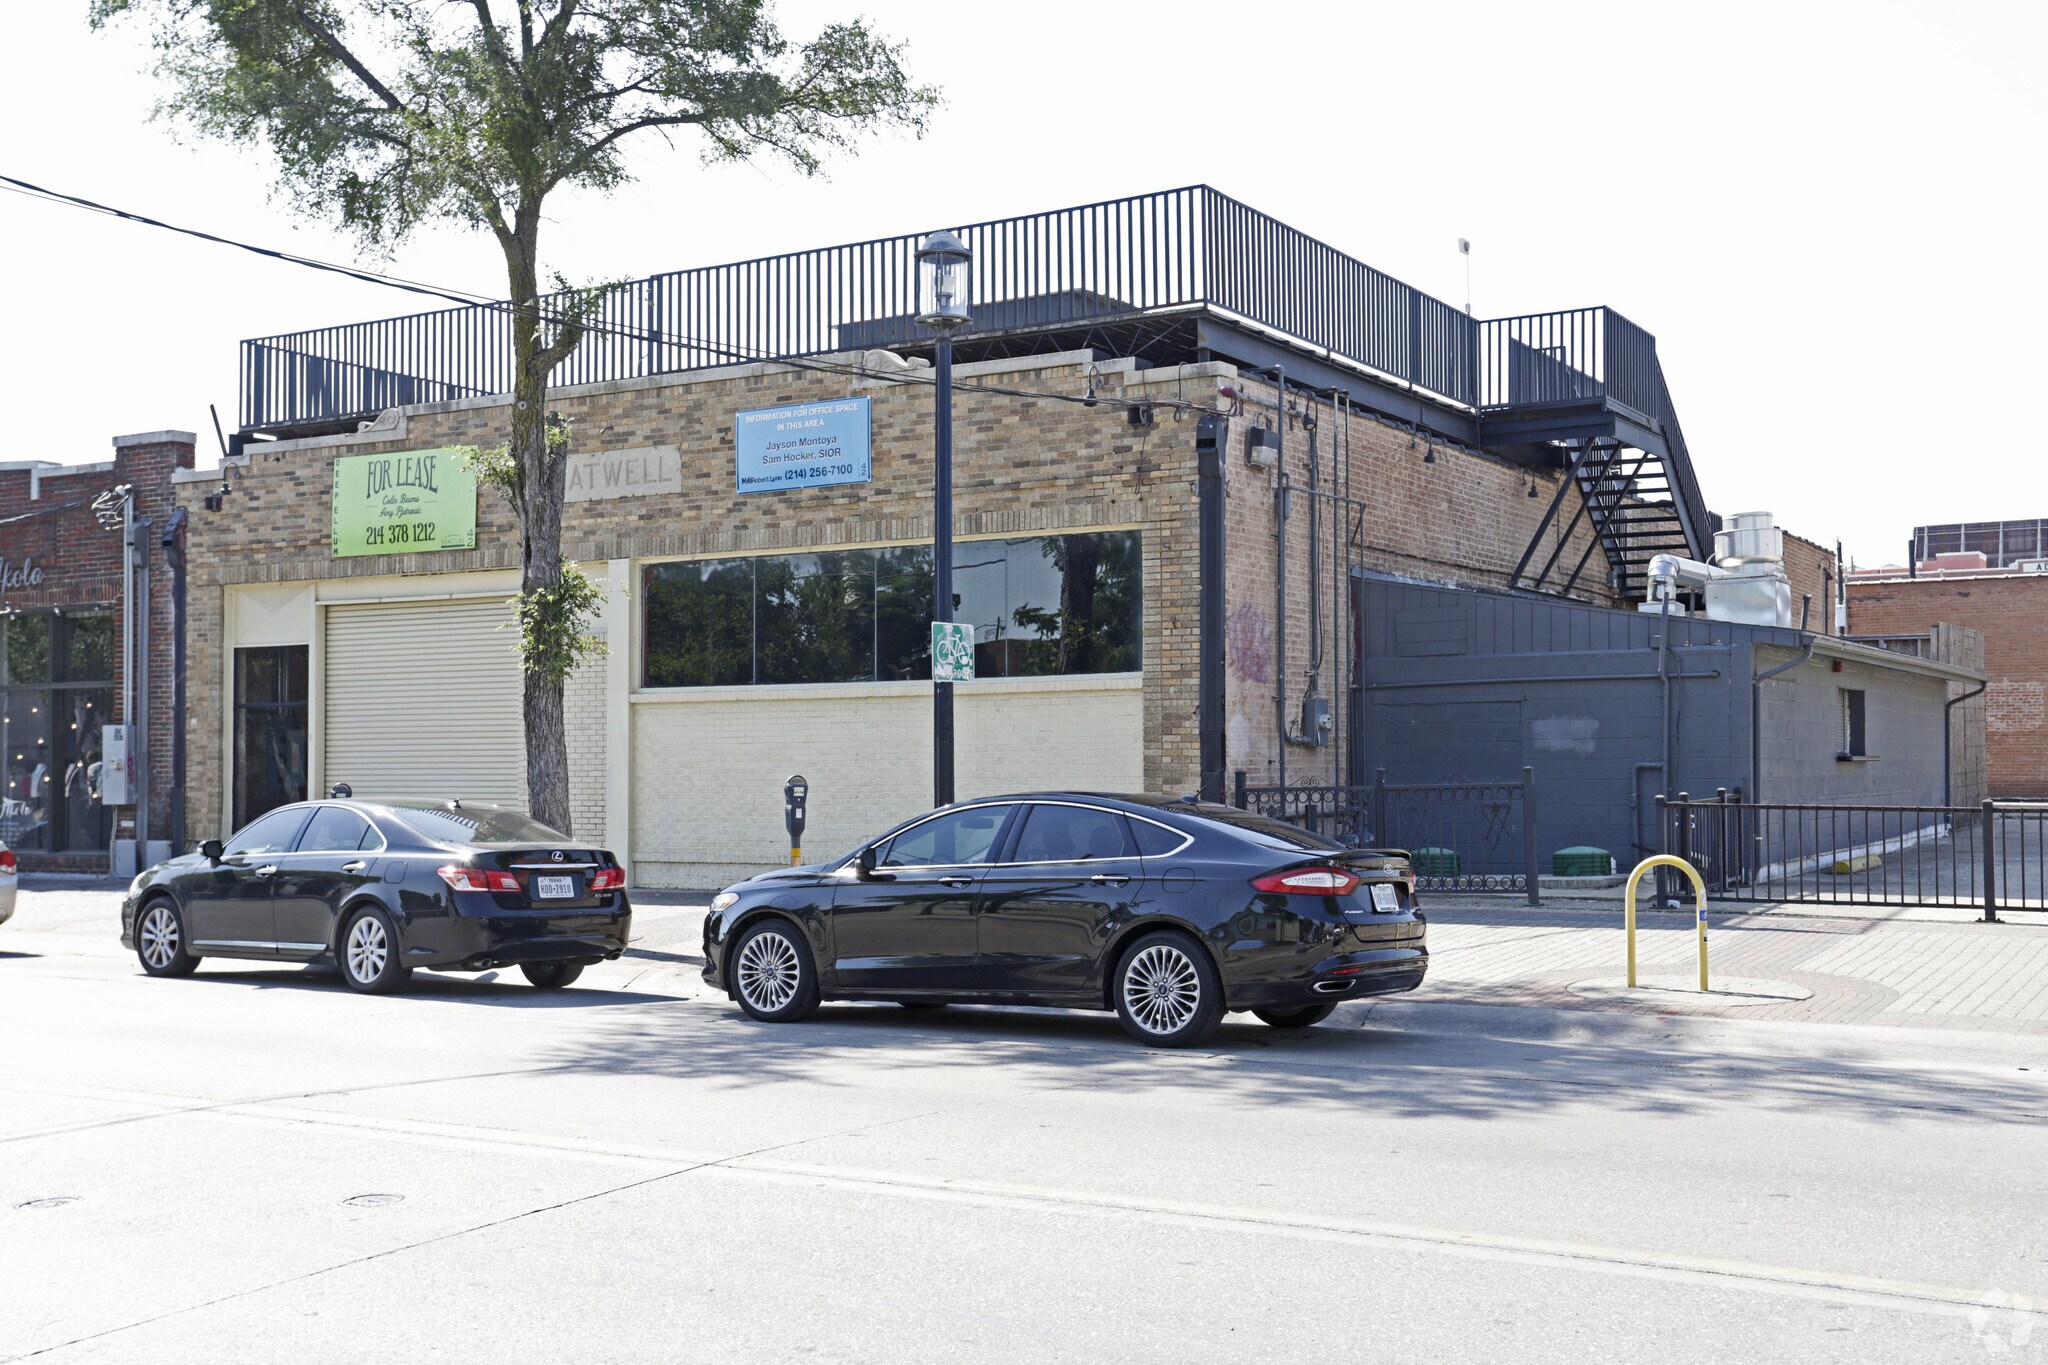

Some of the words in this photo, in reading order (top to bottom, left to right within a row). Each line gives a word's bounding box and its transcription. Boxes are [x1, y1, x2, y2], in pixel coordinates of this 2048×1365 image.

[745, 411, 792, 423] INFORMATION
[793, 408, 808, 418] FOR
[809, 405, 833, 416] OFFICE
[835, 402, 859, 412] SPACE
[777, 422, 784, 431] IN
[786, 421, 803, 430] THIS
[804, 418, 825, 428] AREA
[766, 441, 797, 452] Jayson
[799, 436, 837, 447] Montoya
[762, 455, 781, 464] Sam
[819, 448, 841, 458] SIOR
[366, 460, 392, 499] FOR
[396, 456, 438, 493] LEASE
[569, 456, 674, 491] ATWELL
[784, 468, 807, 480] (214)
[809, 463, 853, 478] 256-7100
[366, 526, 384, 545] 214
[388, 523, 409, 544] 378
[413, 521, 436, 542] 1212
[0, 556, 45, 594] kola
